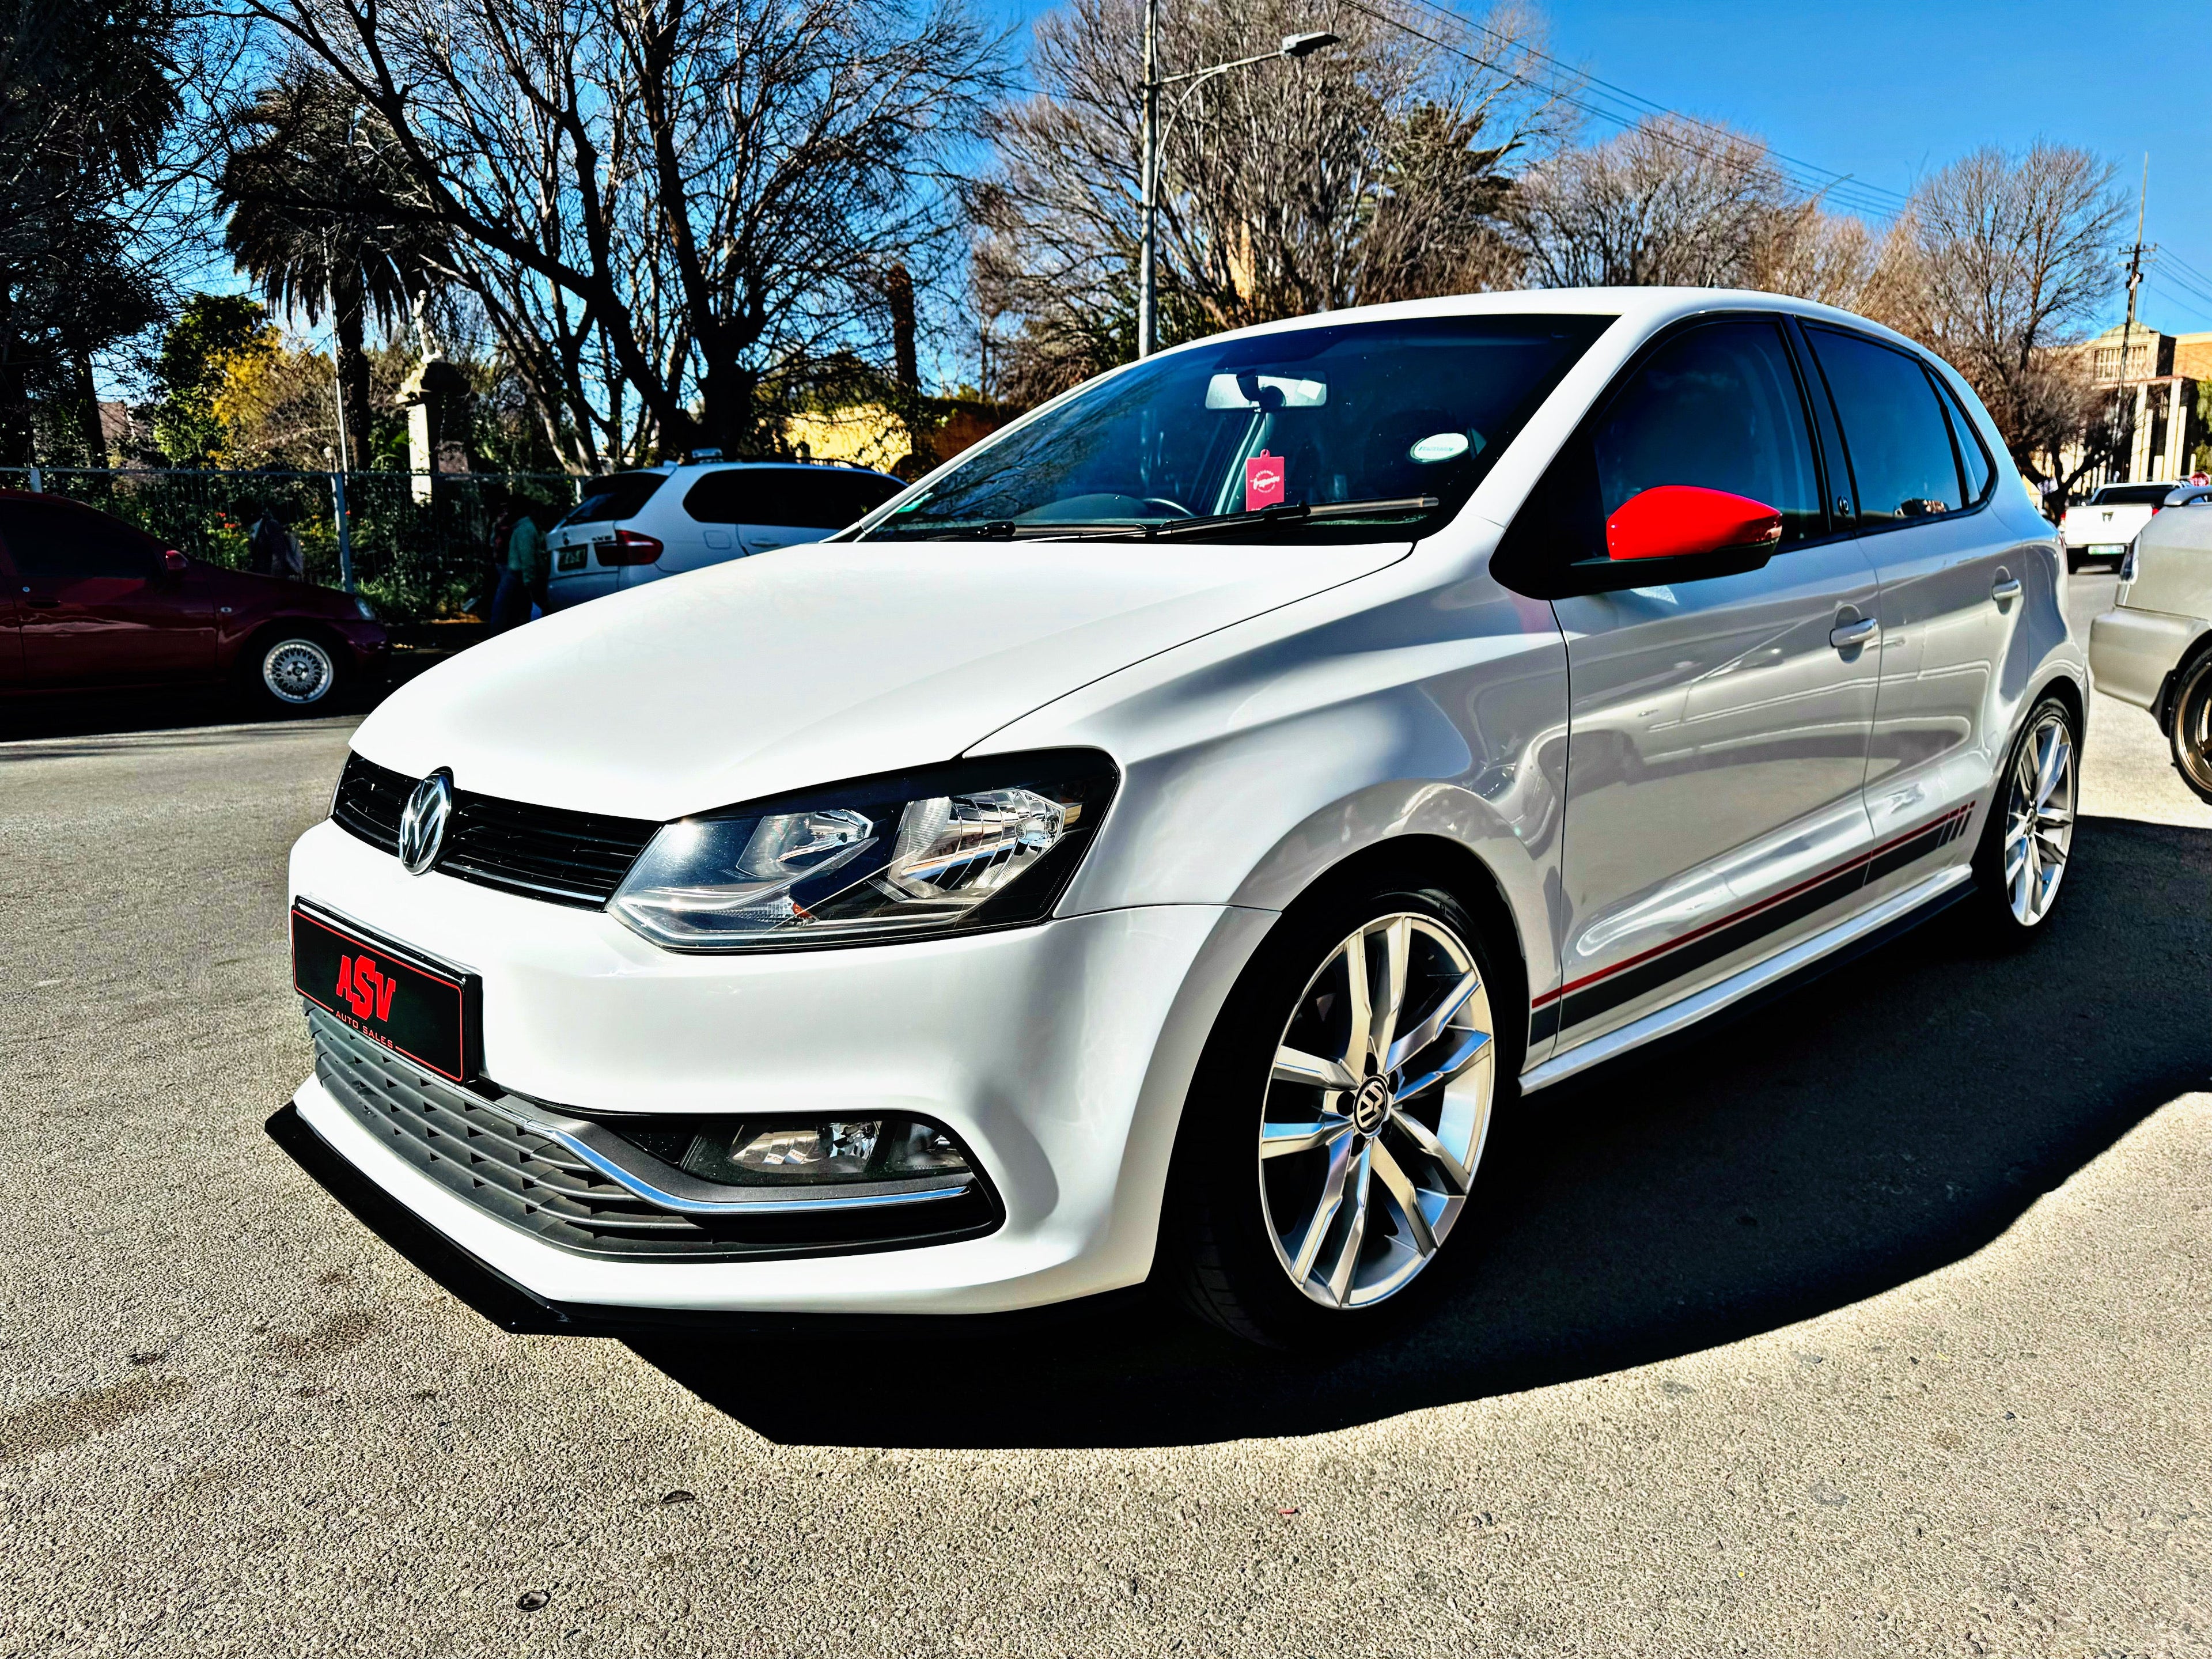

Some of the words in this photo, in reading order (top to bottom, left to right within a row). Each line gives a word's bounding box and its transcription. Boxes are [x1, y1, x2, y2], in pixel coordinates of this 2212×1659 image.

[336, 955, 396, 1022] ASV
[335, 1010, 359, 1029] AUTO
[362, 1025, 393, 1049] SALES
